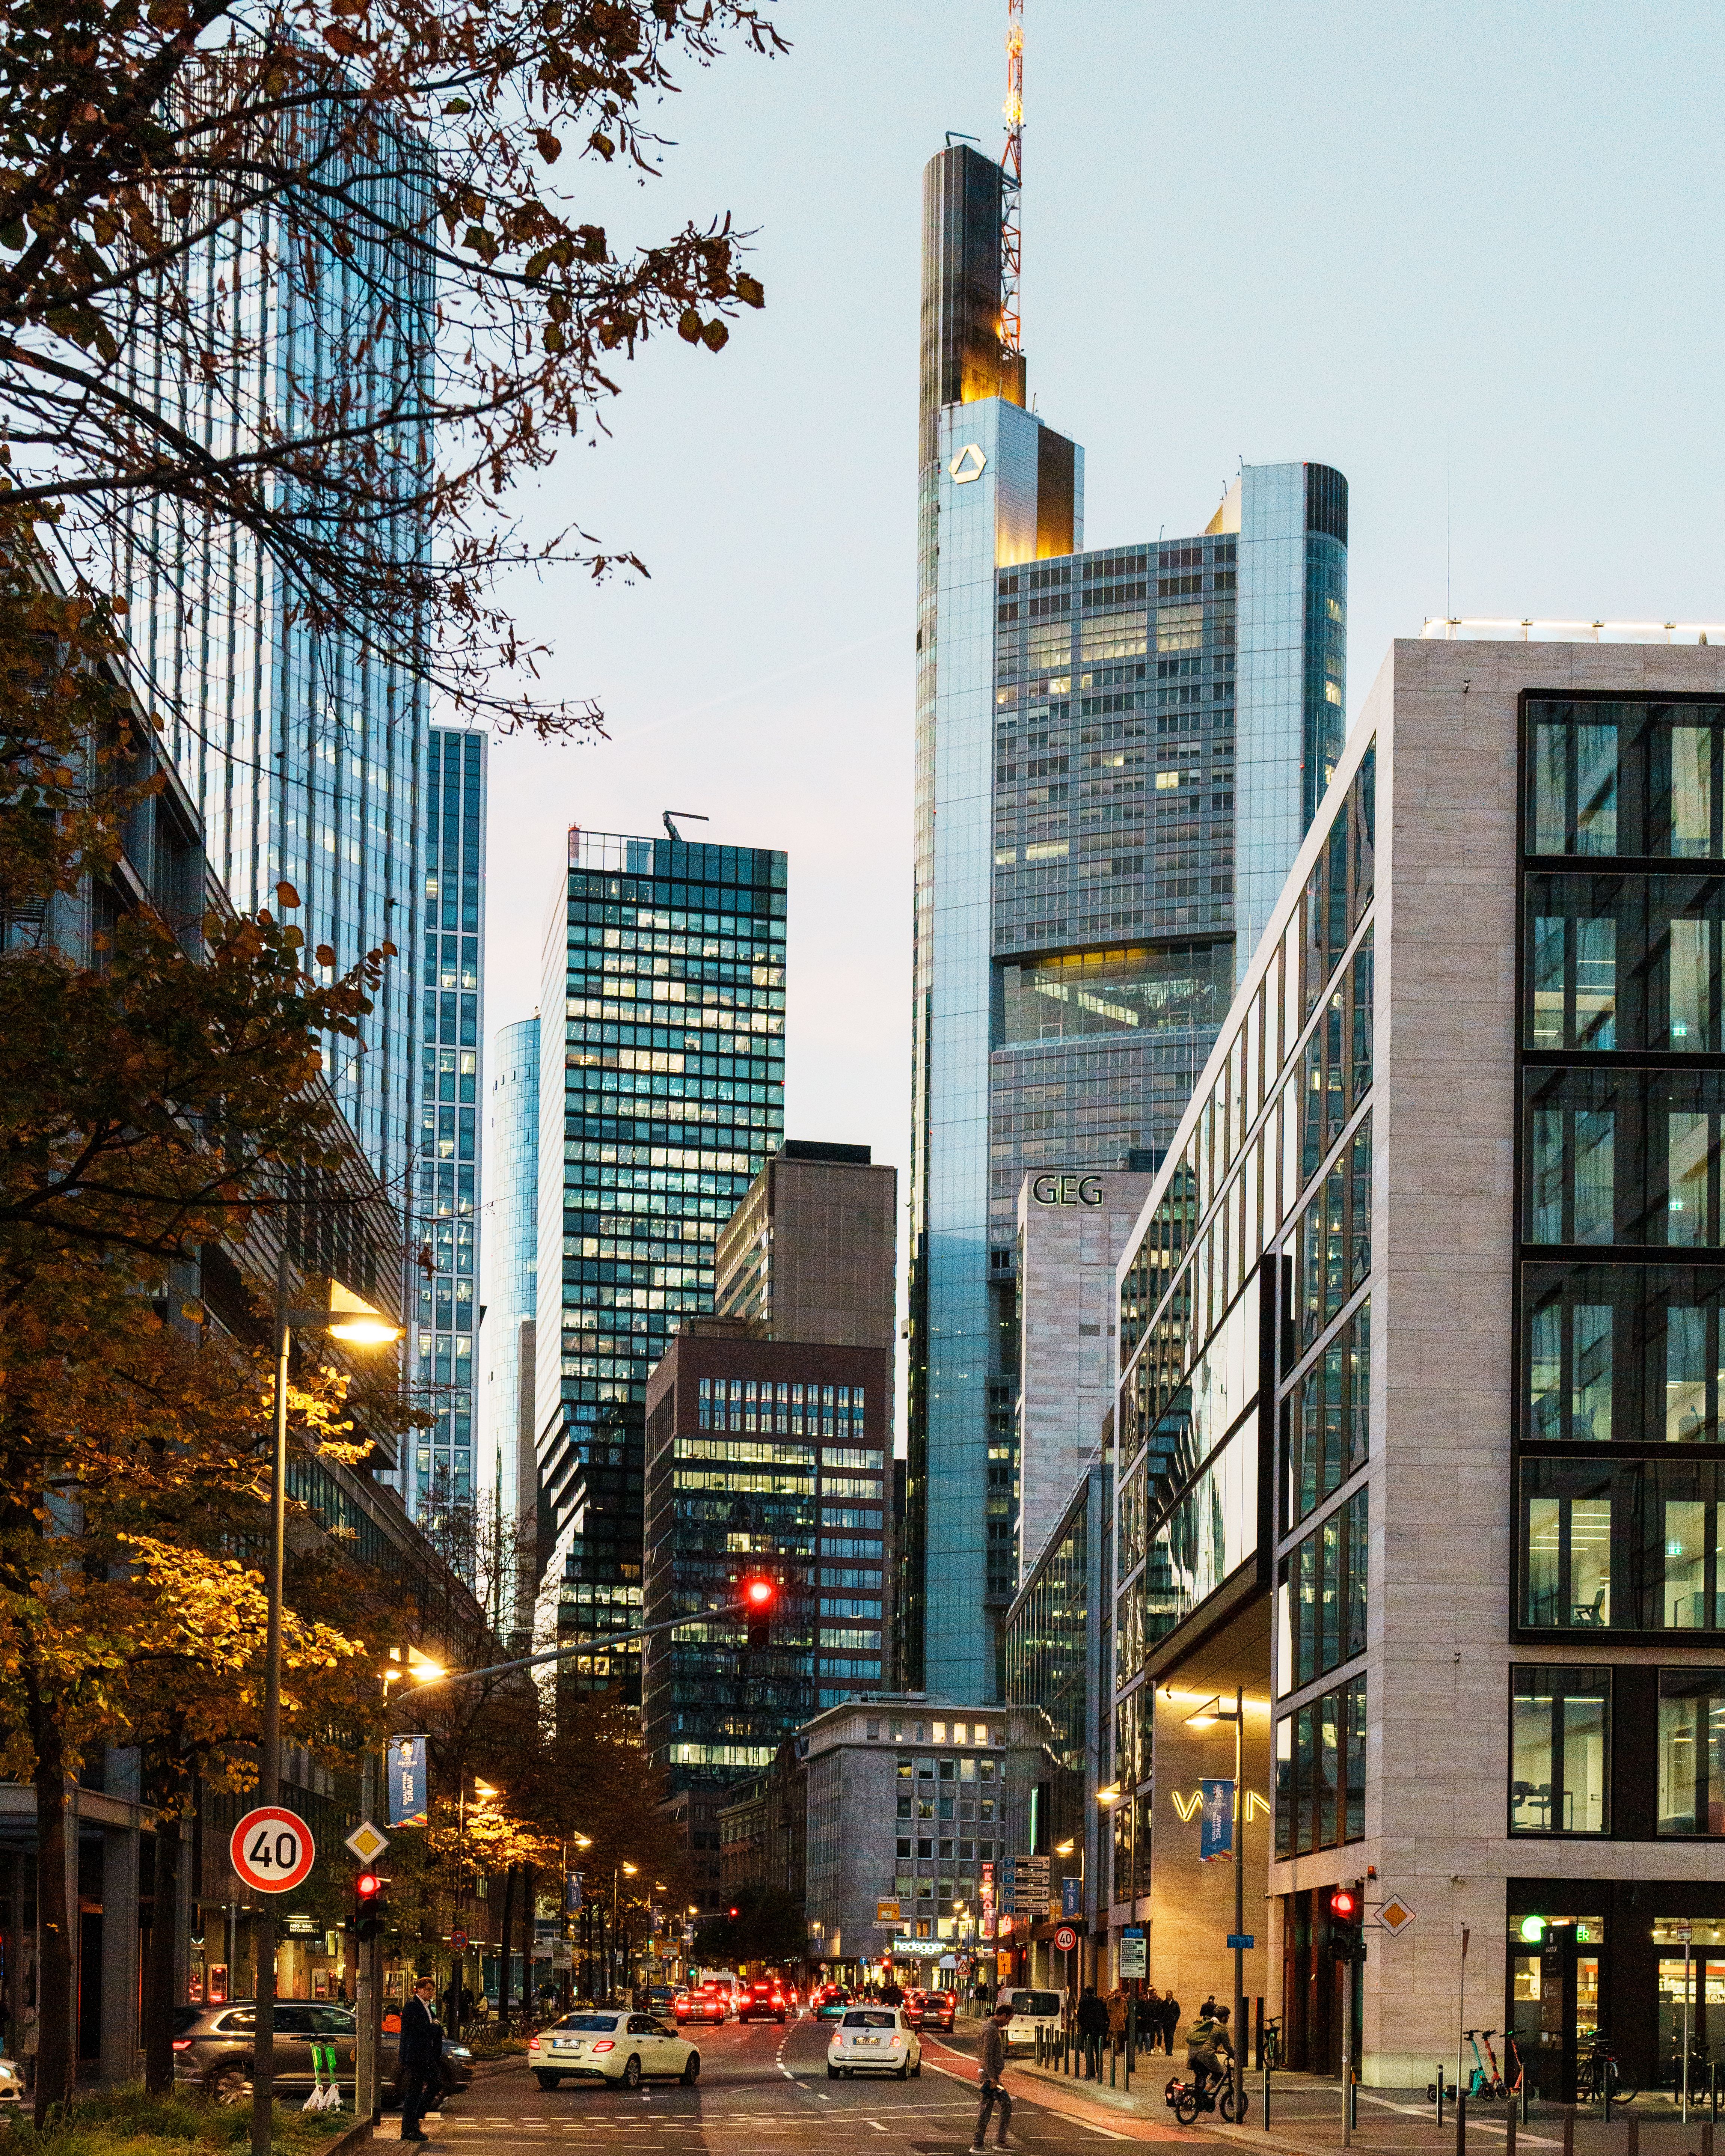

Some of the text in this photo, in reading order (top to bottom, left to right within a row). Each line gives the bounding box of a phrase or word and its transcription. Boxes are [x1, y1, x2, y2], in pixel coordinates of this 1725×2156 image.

[1033, 1175, 1104, 1206] GEG
[249, 1831, 297, 1869] 40
[894, 1941, 947, 1954] hedegger
[1059, 1934, 1071, 1944] 40
